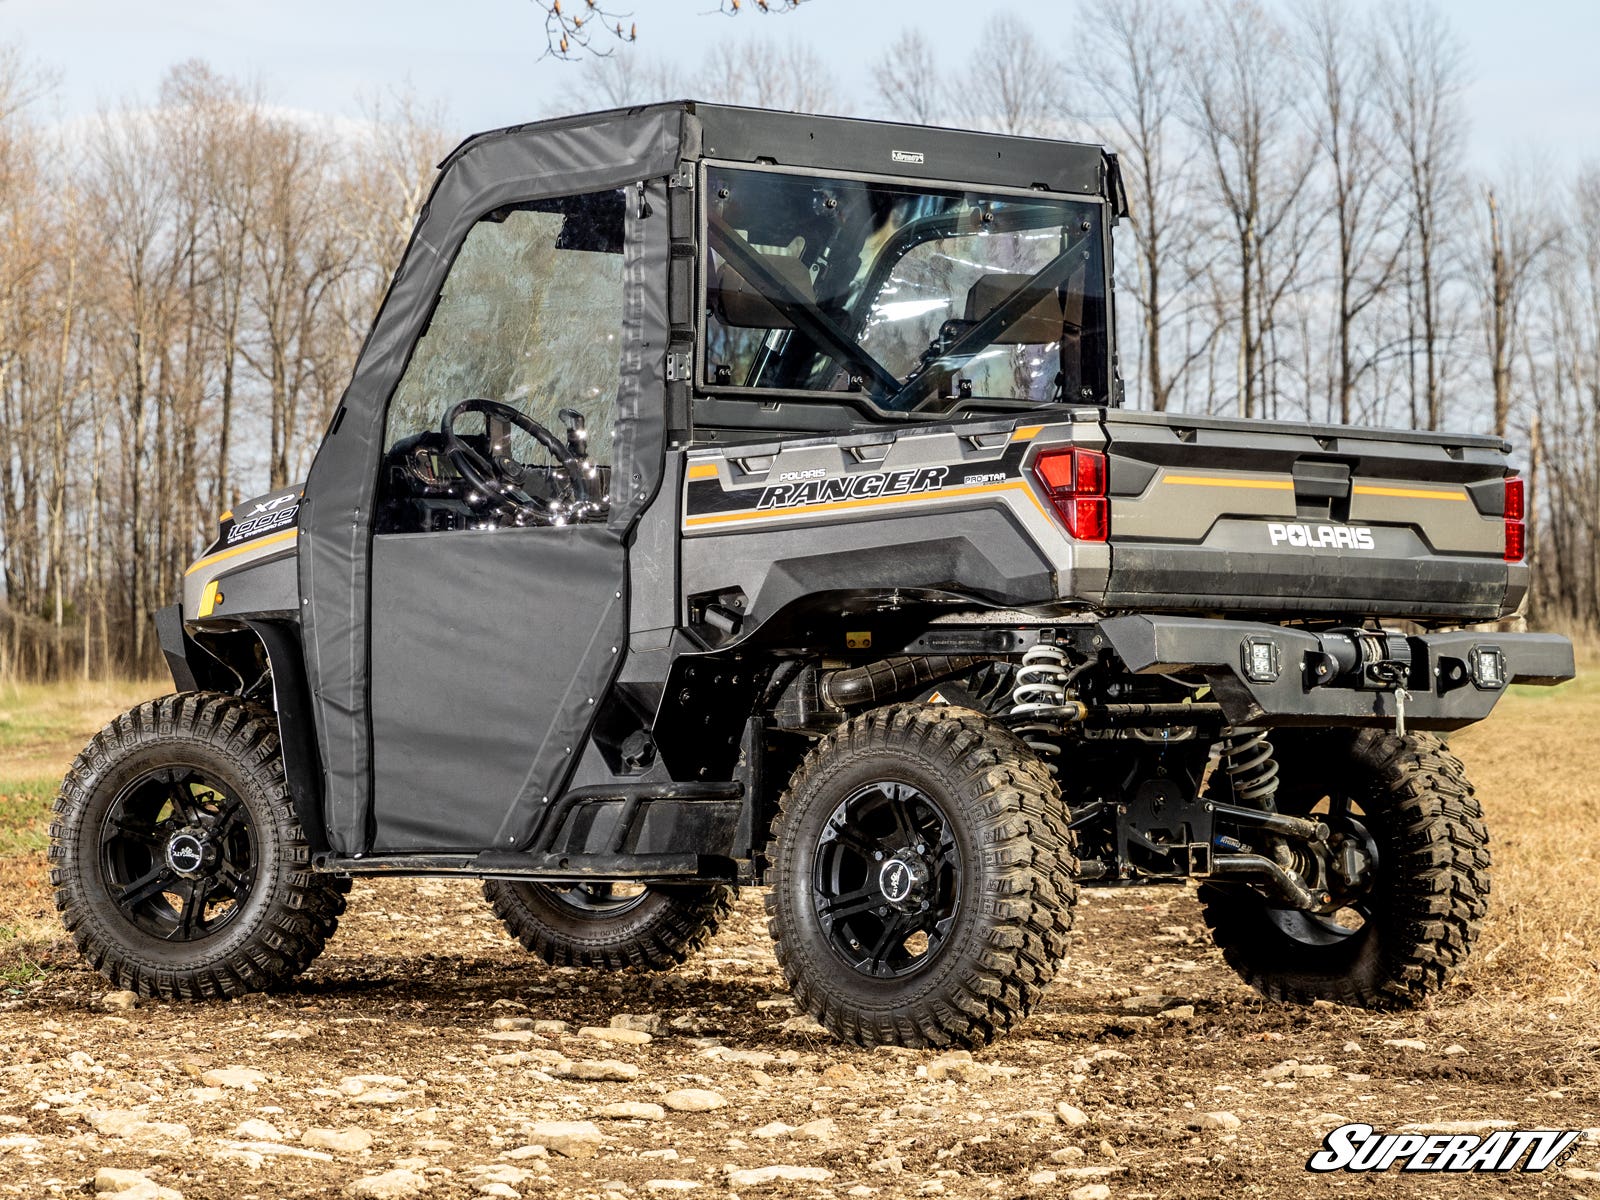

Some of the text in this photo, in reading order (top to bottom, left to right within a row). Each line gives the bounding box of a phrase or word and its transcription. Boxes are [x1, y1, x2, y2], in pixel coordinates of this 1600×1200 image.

[779, 469, 825, 481] POLARIS
[964, 472, 1006, 484] PROSTAR
[756, 465, 949, 510] RANGER
[246, 494, 295, 517] XP
[227, 505, 299, 539] 1000
[1267, 523, 1375, 549] POLARIS
